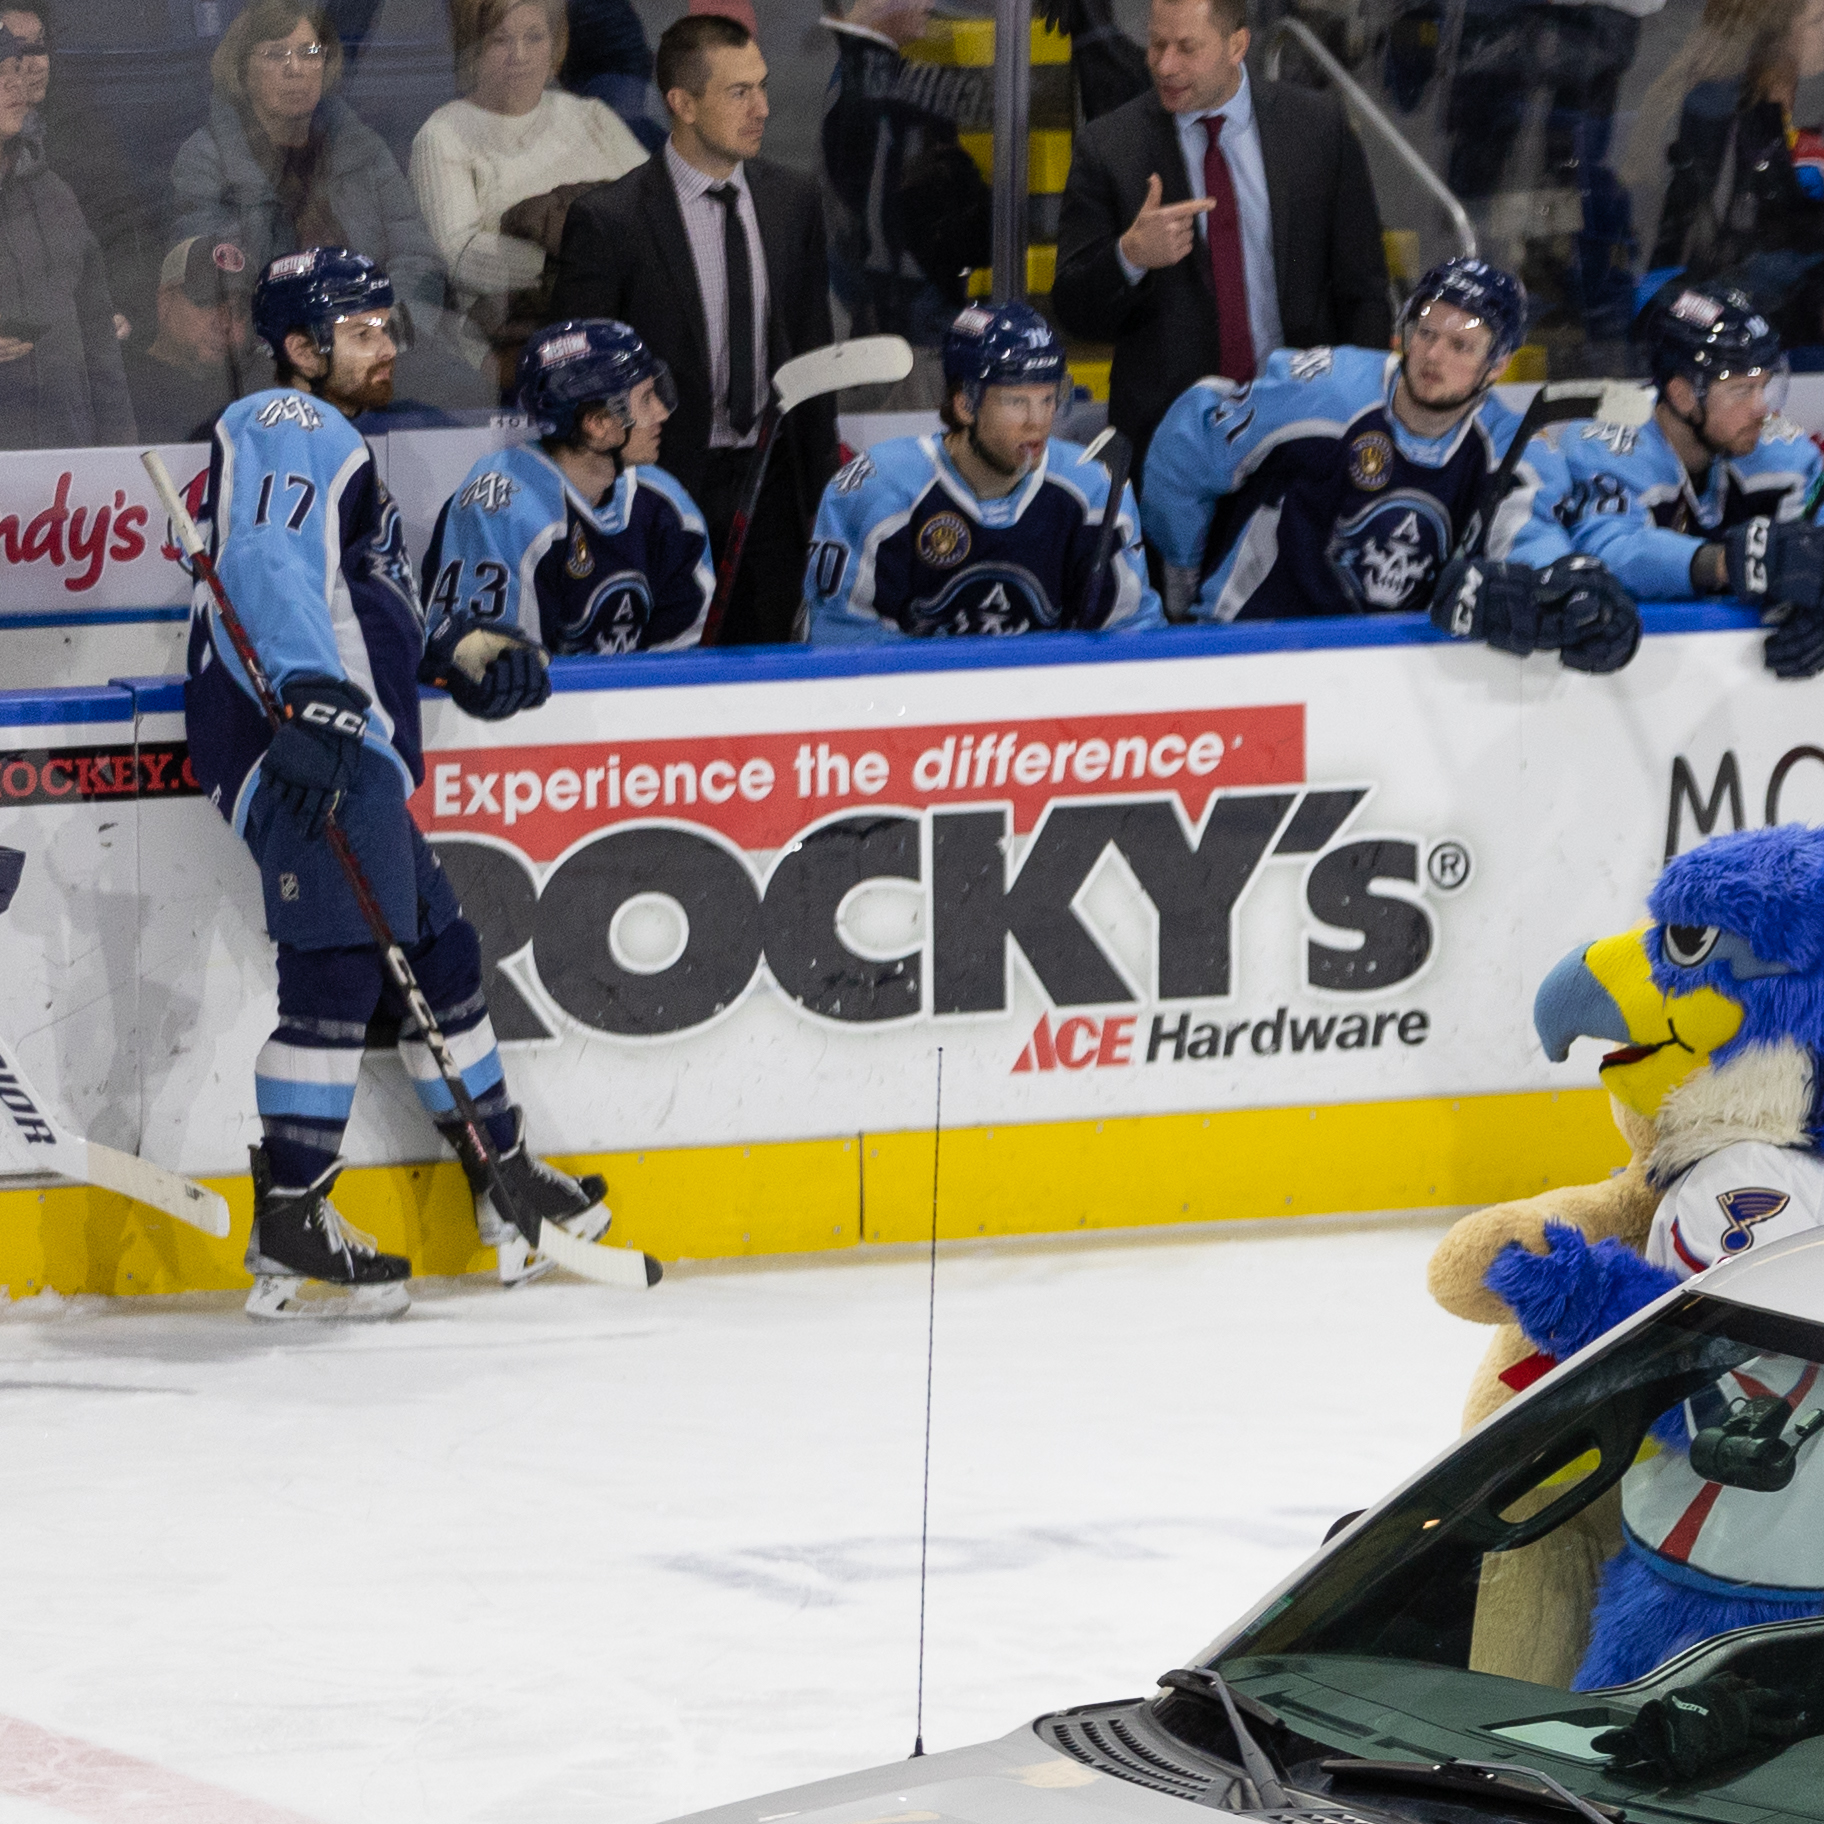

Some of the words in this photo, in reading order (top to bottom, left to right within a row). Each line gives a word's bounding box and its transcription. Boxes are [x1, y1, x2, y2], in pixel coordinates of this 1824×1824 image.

[254, 470, 318, 535] 17
[432, 559, 511, 622] 43
[434, 752, 777, 825] Experience
[795, 743, 891, 797] the
[911, 730, 1227, 795] difference
[1010, 1009, 1138, 1074] ACE
[1146, 1004, 1431, 1064] Hardware
